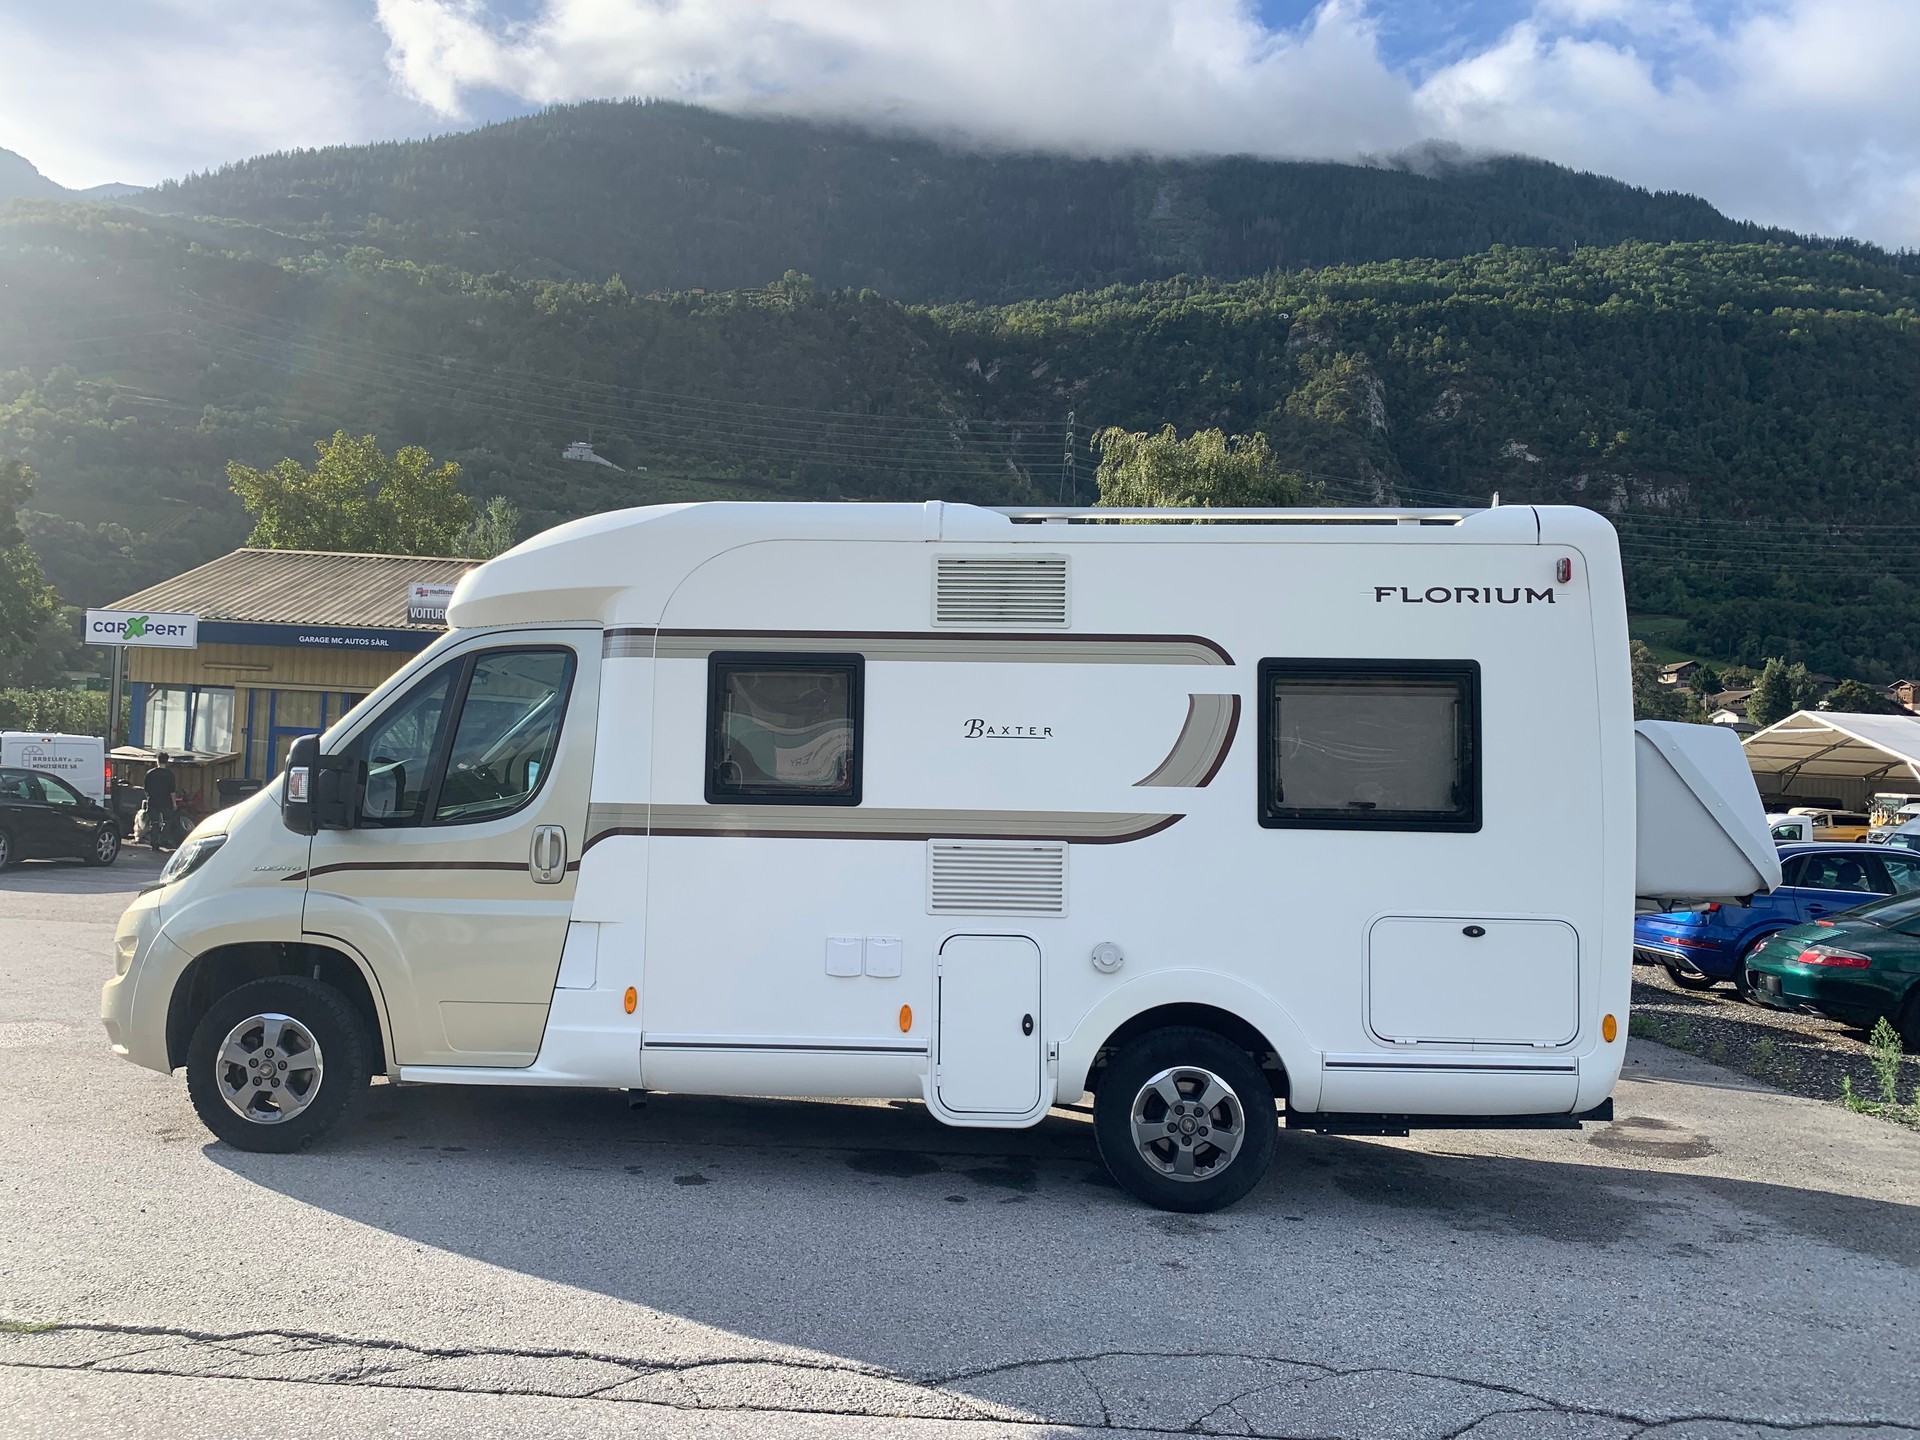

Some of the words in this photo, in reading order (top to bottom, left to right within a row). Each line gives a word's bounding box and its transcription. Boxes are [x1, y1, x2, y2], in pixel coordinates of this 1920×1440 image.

[1374, 586, 1556, 604] FLORIUM
[410, 607, 447, 620] VOITUR
[299, 635, 330, 644] GARAGE
[331, 637, 343, 645] MC
[344, 638, 369, 646] AUTOS
